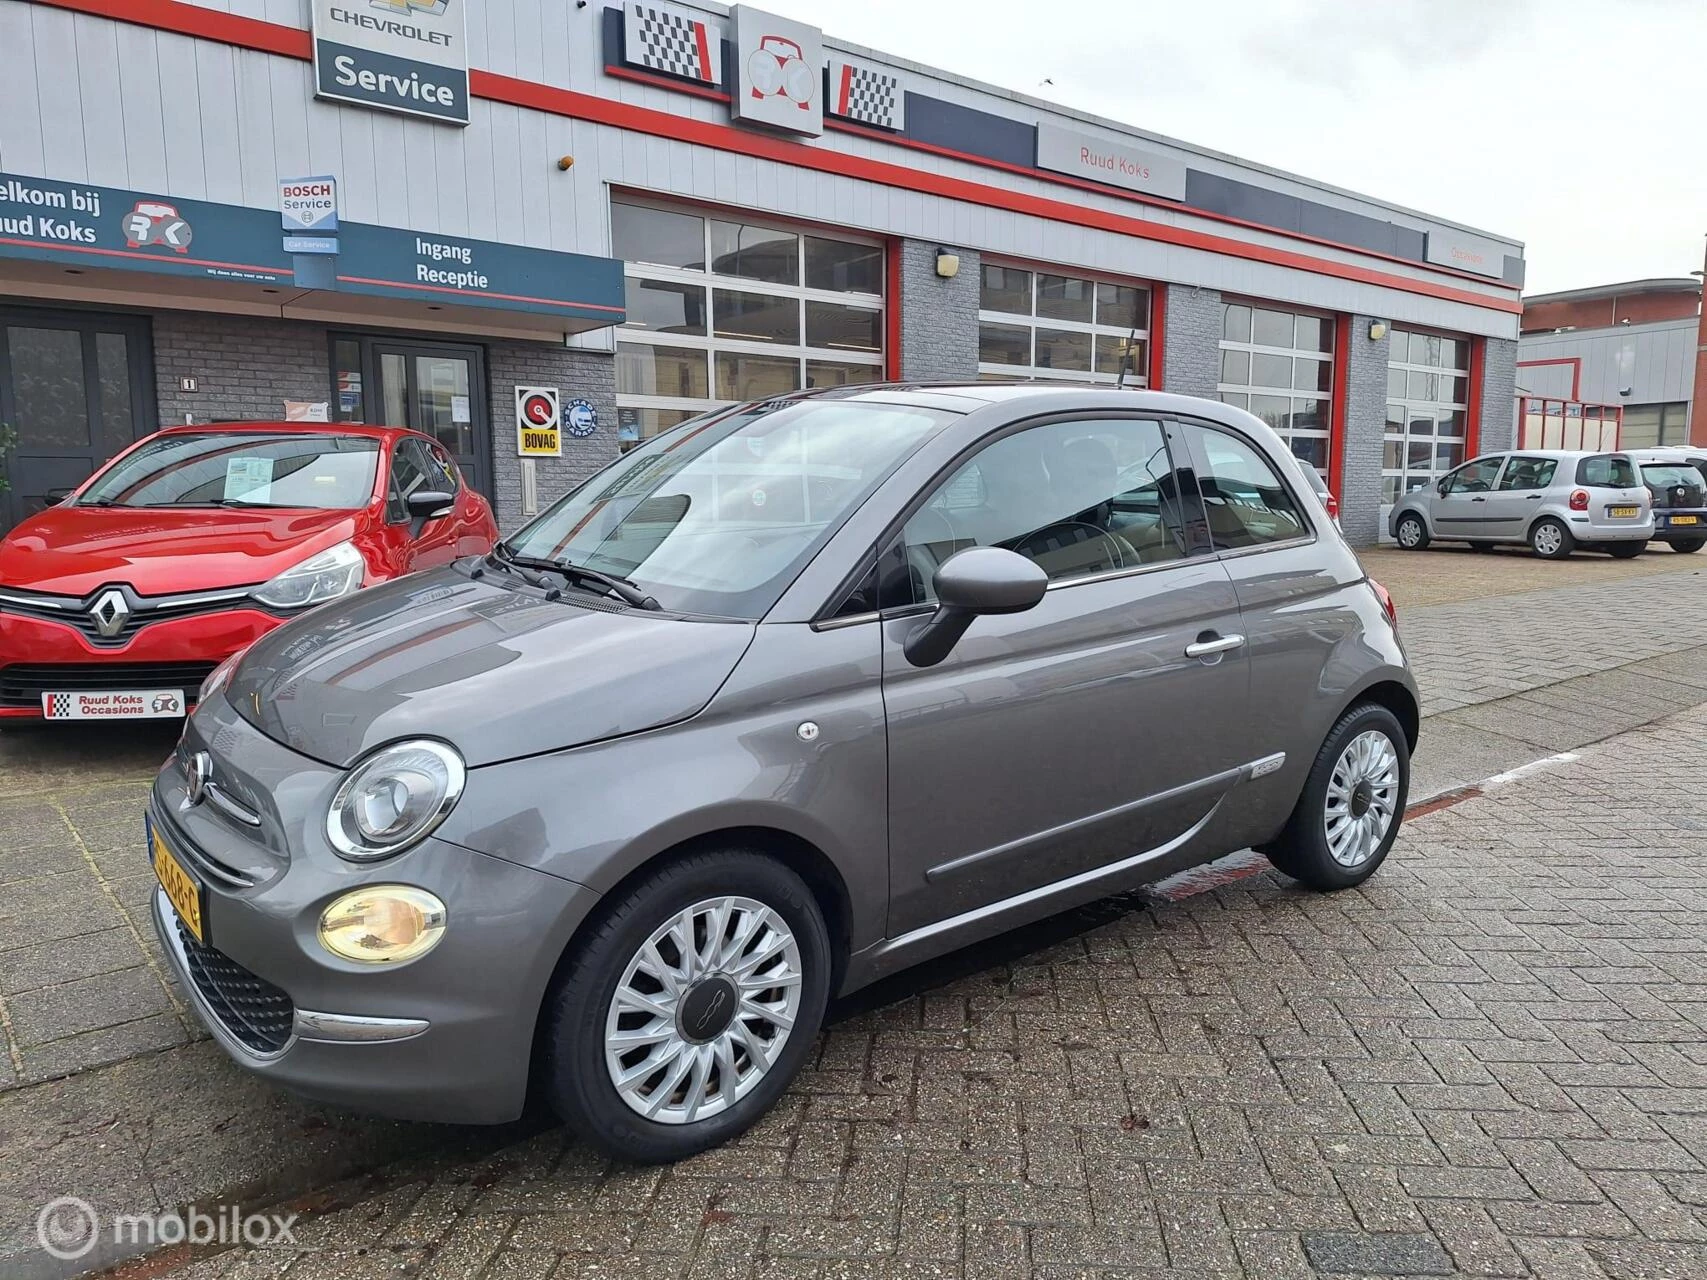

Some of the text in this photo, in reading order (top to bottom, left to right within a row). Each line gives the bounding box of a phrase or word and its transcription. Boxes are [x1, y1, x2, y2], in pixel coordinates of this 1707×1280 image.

[330, 8, 452, 46] CHEVROLET
[334, 55, 454, 106] Service
[1080, 146, 1150, 179] Ruud Koks
[283, 184, 331, 198] BOSCH
[72, 189, 100, 217] bij
[284, 198, 331, 210] Service
[39, 217, 97, 243] Koks
[303, 240, 330, 249] Service
[416, 237, 471, 264] Ingang
[416, 264, 488, 289] Receptie
[564, 400, 597, 417] SCHADE
[565, 421, 596, 437] GARANT
[524, 432, 556, 449] BOVAG
[79, 694, 143, 705] Ruud Koks
[81, 705, 144, 715] Occasions
